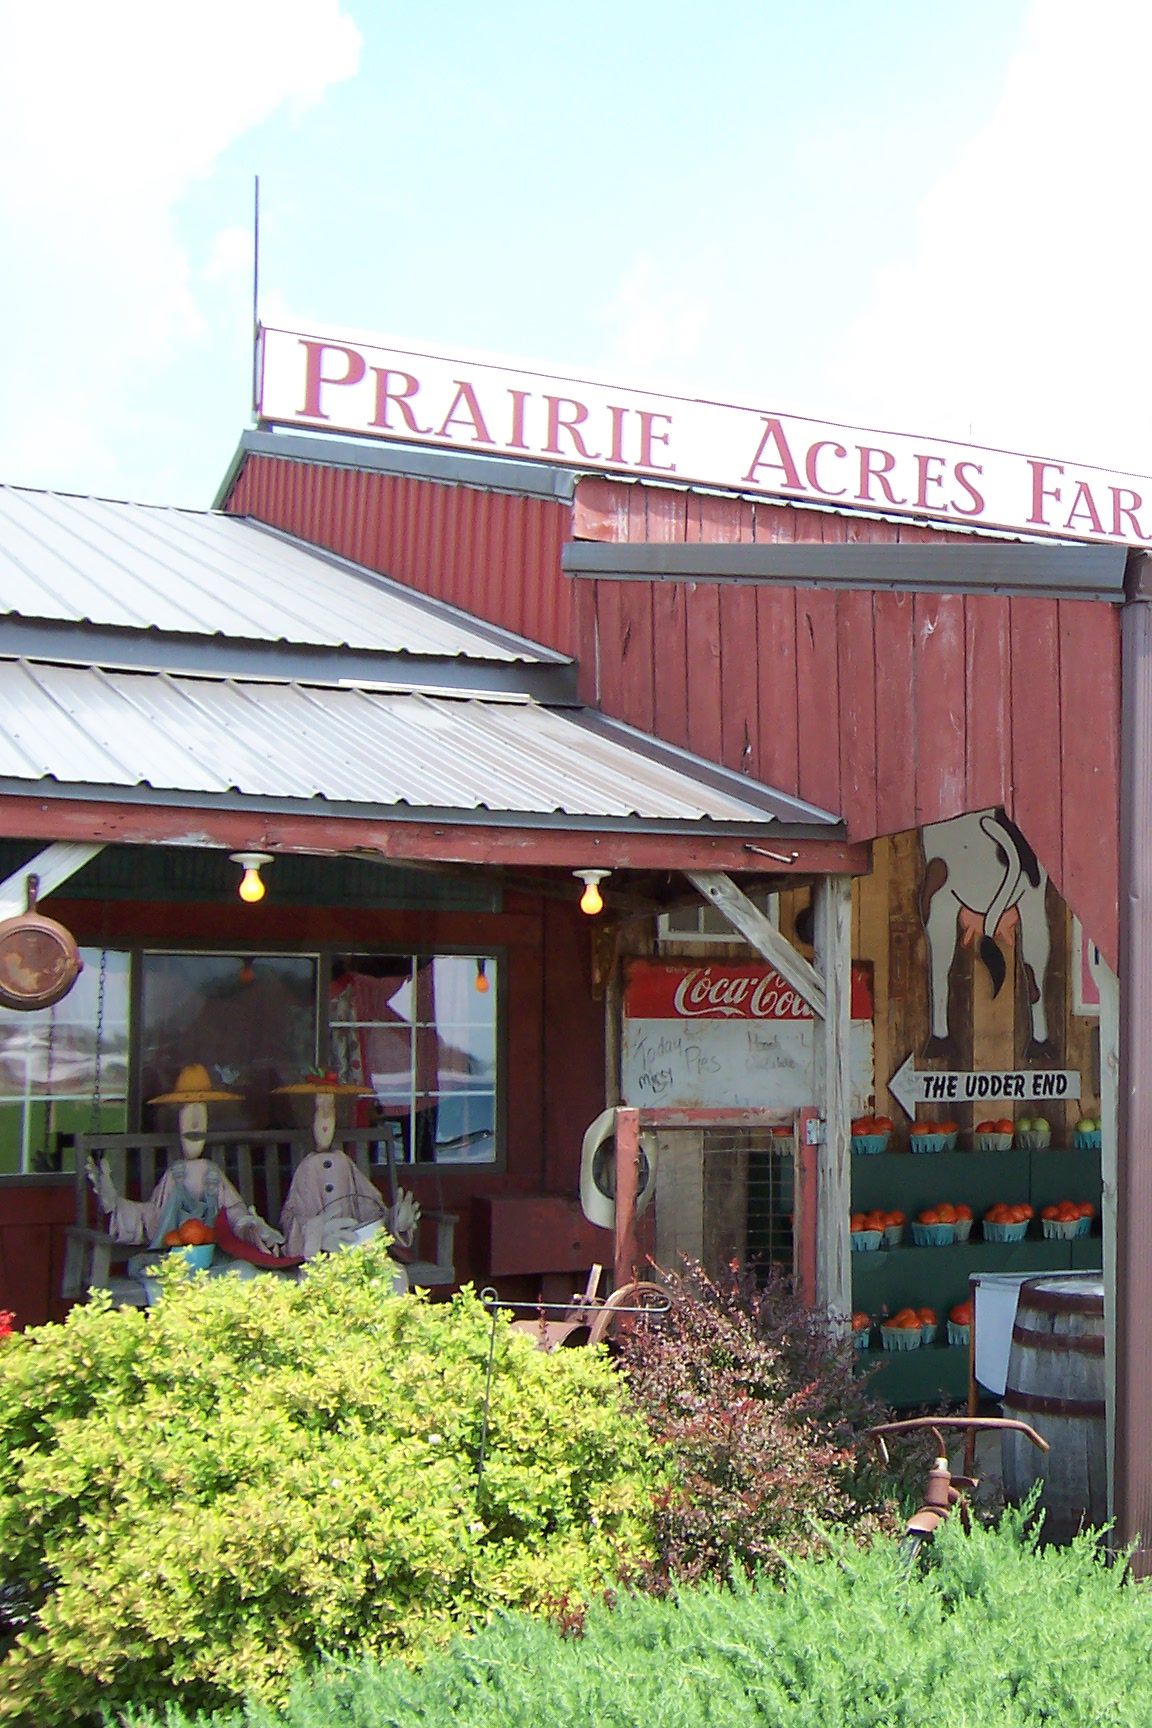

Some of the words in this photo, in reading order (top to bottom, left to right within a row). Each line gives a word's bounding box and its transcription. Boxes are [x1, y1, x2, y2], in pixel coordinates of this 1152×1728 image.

[297, 338, 677, 472] PRAIRIE
[741, 416, 985, 516] ACRES
[923, 1075, 958, 1098] THE
[965, 1074, 1026, 1098] UDDER
[1032, 1074, 1068, 1096] END
